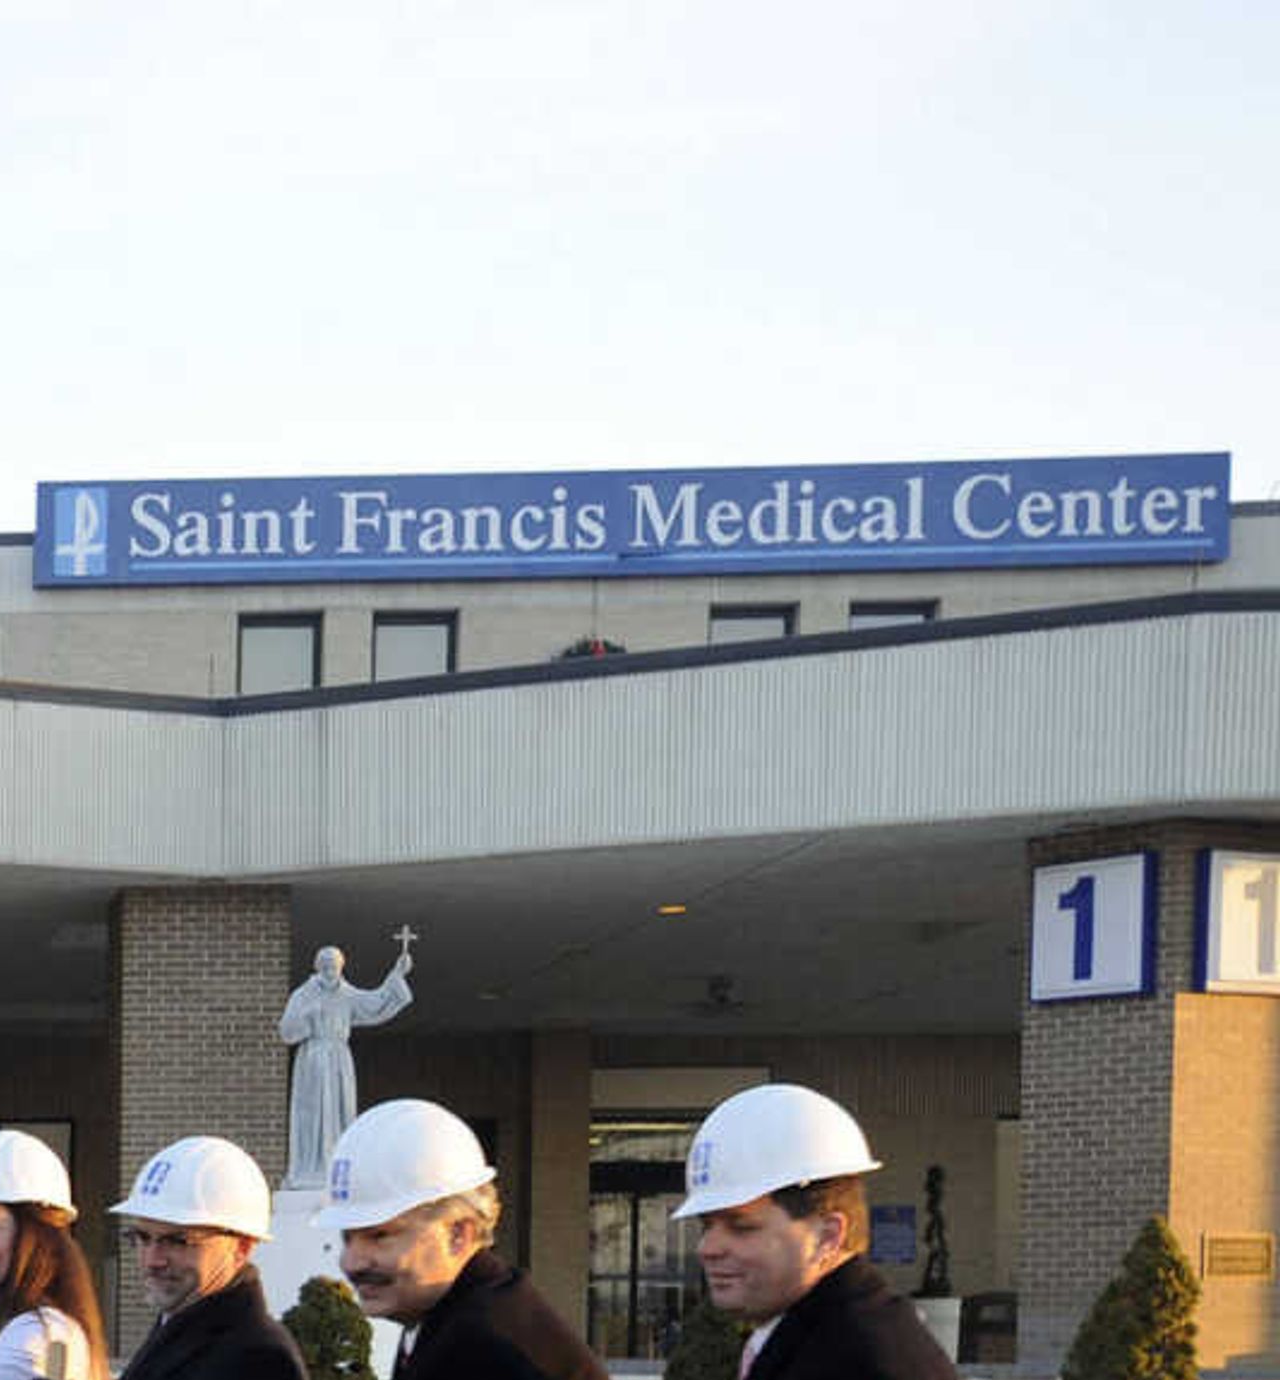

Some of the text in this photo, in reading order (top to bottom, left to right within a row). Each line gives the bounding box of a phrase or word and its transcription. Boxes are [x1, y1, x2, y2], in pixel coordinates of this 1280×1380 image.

[128, 472, 1217, 557] Saint Francis Medical Center
[1058, 874, 1096, 982] 1
[1243, 865, 1280, 976] 1
